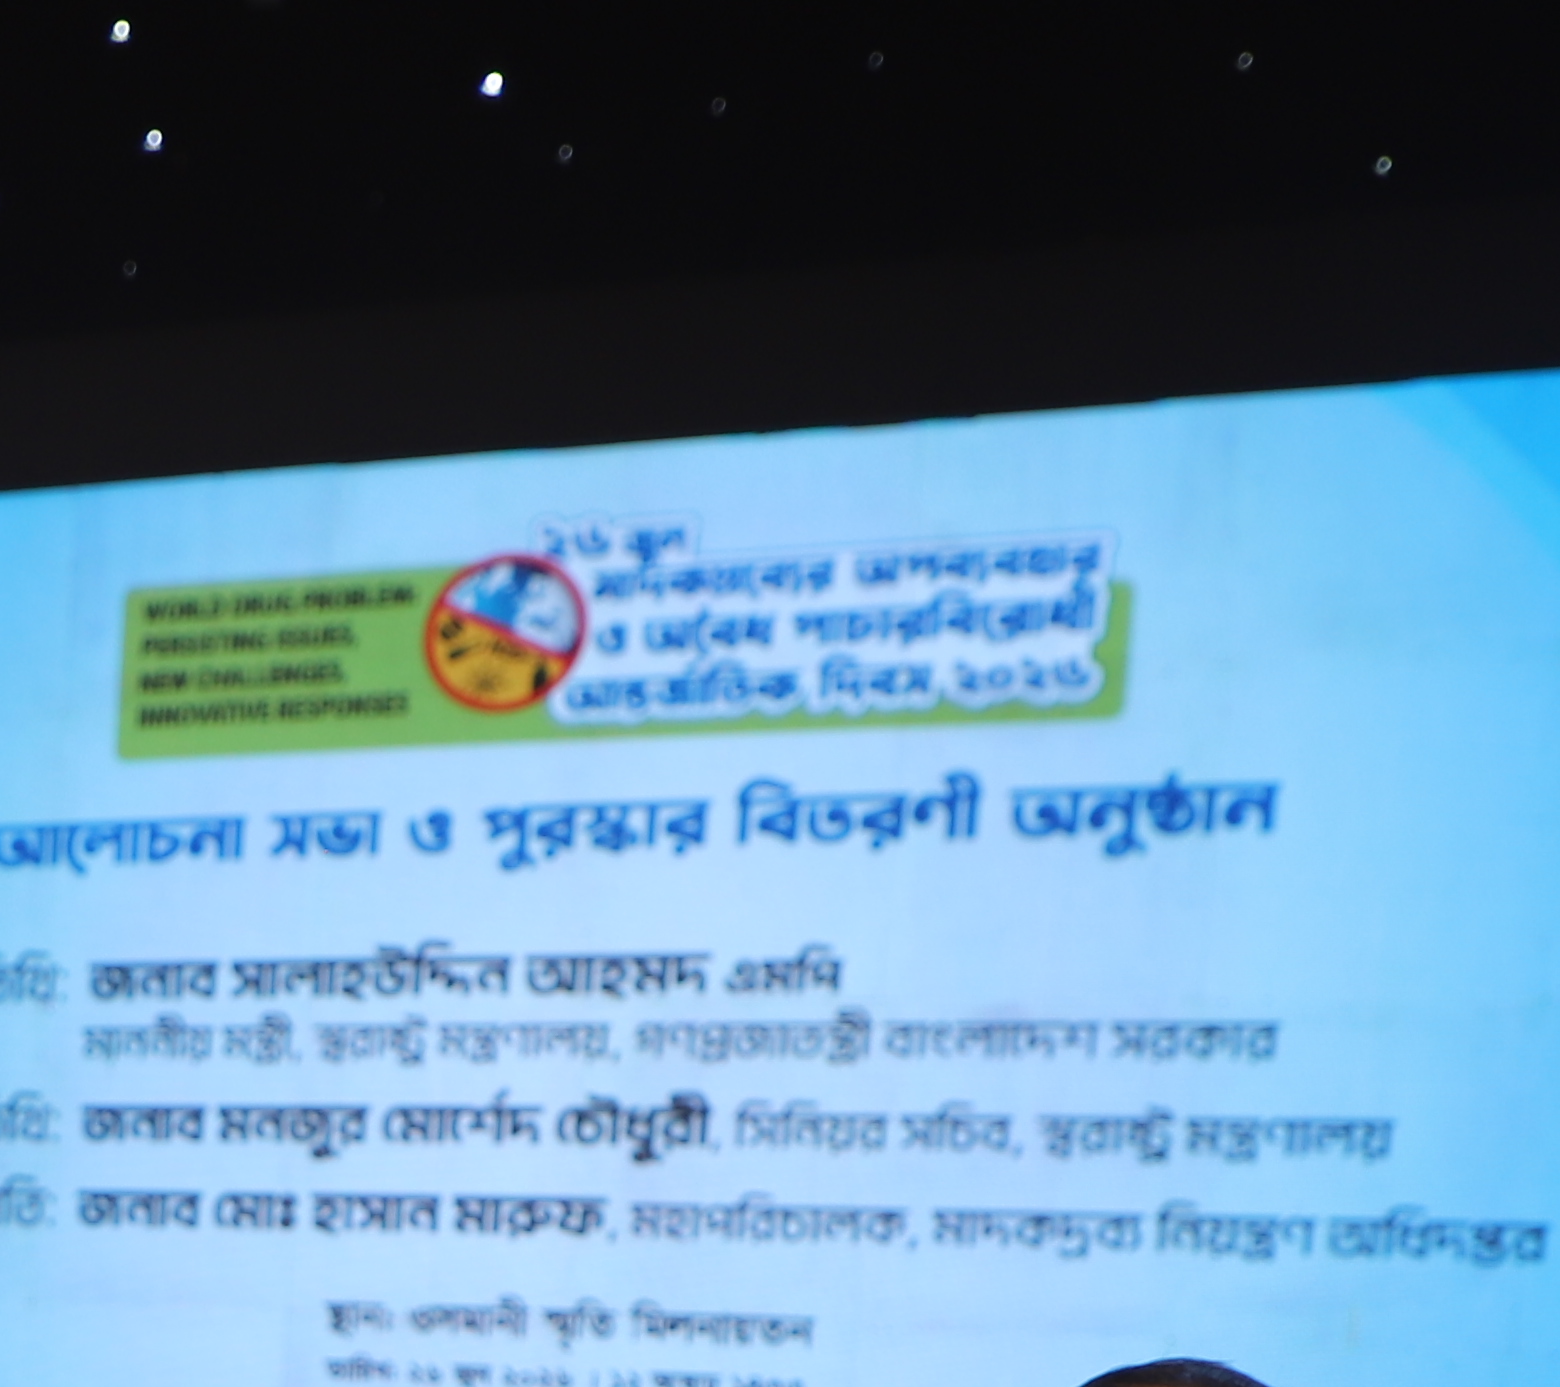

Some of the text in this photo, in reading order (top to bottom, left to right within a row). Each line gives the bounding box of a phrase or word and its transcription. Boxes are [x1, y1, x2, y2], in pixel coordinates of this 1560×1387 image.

[542, 526, 608, 556] ২৬
[271, 809, 383, 857] সভা
[409, 809, 454, 854] ও
[483, 797, 710, 872] পুরস্কার
[736, 771, 981, 853] বিতরণী
[1011, 767, 1280, 858] অনুষ্ঠান
[90, 961, 218, 1001] জনাব
[232, 939, 510, 1001] সালাহউদ্দিন
[526, 951, 710, 998] আহমদ
[724, 943, 844, 996] এমপি
[83, 1012, 214, 1061] মাননীয়
[883, 1020, 1095, 1061] বাংলাদেশ
[1109, 1018, 1280, 1063] সরকার
[83, 1104, 205, 1143] জনাব
[218, 1104, 367, 1160] মনজুর
[383, 1089, 541, 1146] মোর্শেদ
[736, 1099, 888, 1153] সিনিয়র
[1187, 1114, 1395, 1162] মন্ত্রণালয়
[78, 1188, 201, 1229] জনাব
[310, 1192, 439, 1235] হাসান
[1326, 1203, 1551, 1269] অধিদপ্তর
